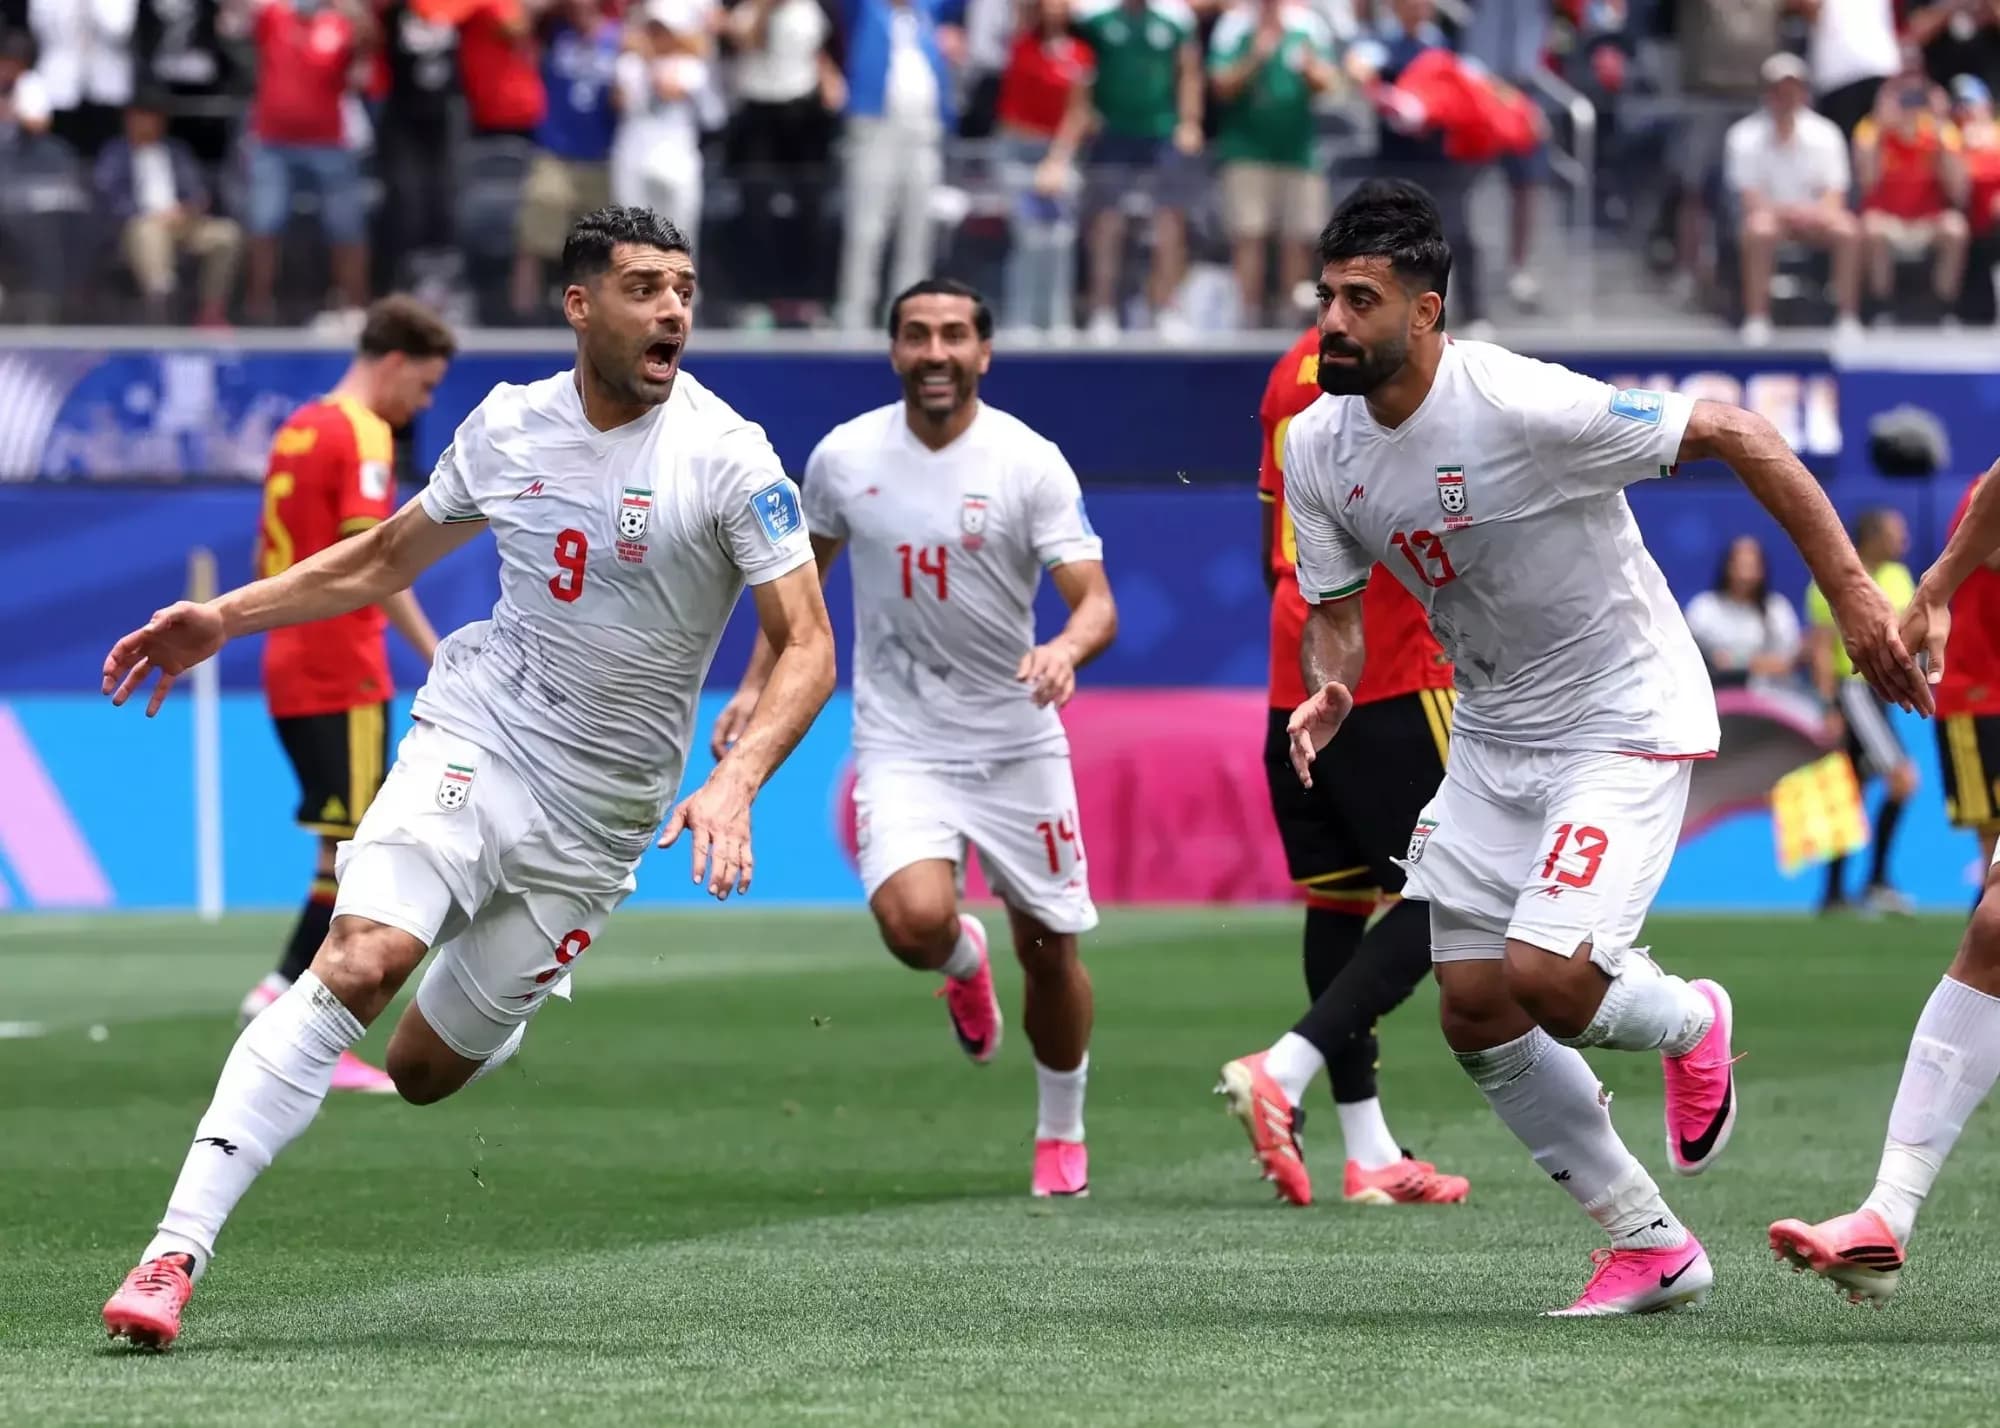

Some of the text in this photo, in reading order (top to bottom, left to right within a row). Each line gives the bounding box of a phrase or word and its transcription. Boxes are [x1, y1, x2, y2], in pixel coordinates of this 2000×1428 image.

[548, 527, 588, 603] 9
[896, 543, 949, 602] 14
[1391, 529, 1458, 588] 13
[1541, 822, 1609, 889] 13
